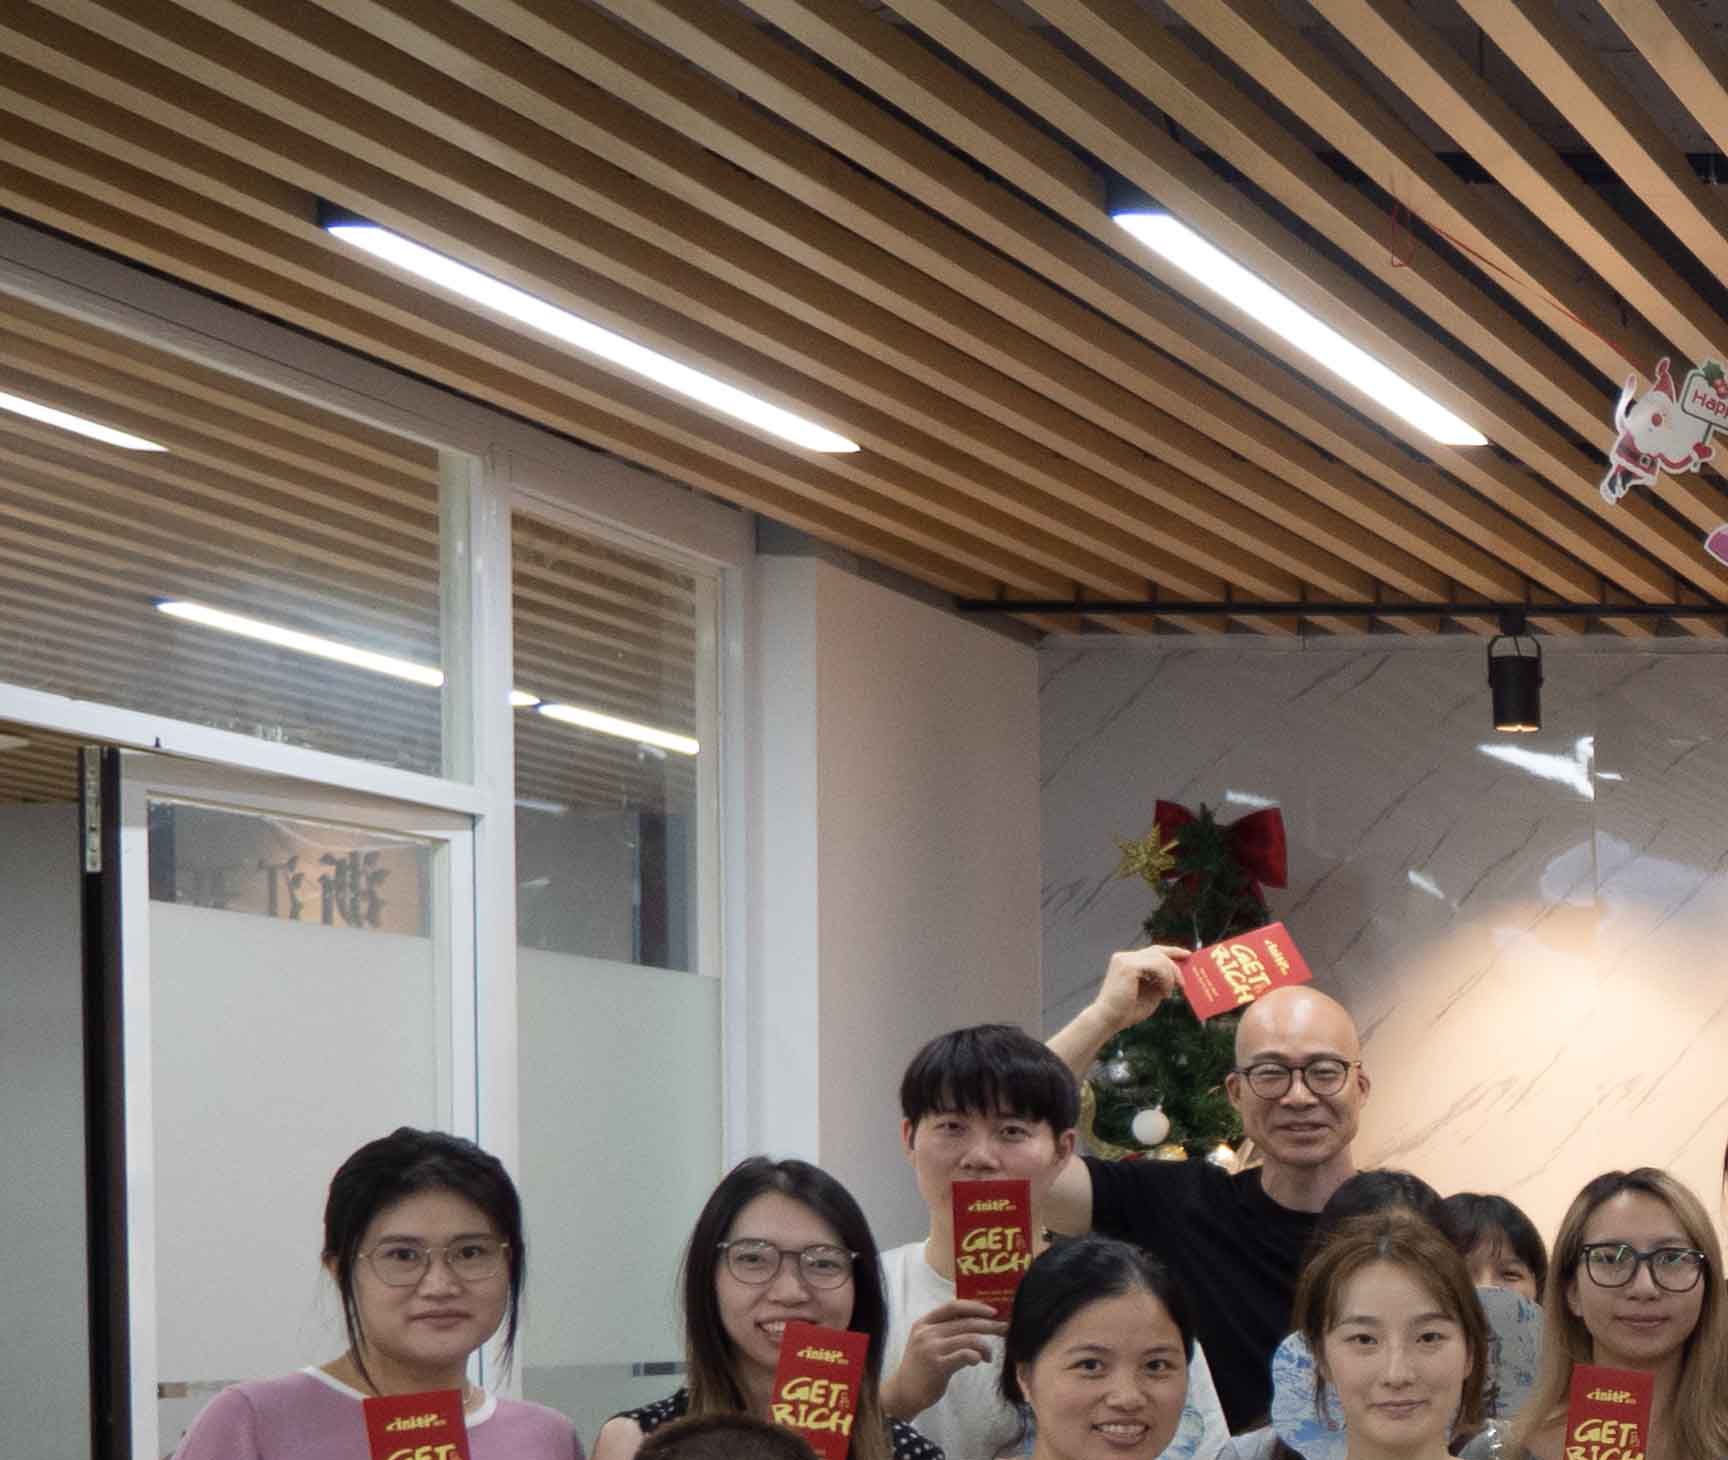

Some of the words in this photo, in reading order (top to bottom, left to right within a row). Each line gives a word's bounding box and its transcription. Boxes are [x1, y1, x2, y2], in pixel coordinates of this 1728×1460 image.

[1230, 943, 1271, 985] GET
[961, 1226, 1021, 1252] GET
[955, 1251, 1031, 1275] RICH
[781, 1376, 848, 1408] GET
[771, 1403, 853, 1436] RICH
[1573, 1418, 1637, 1448] GET
